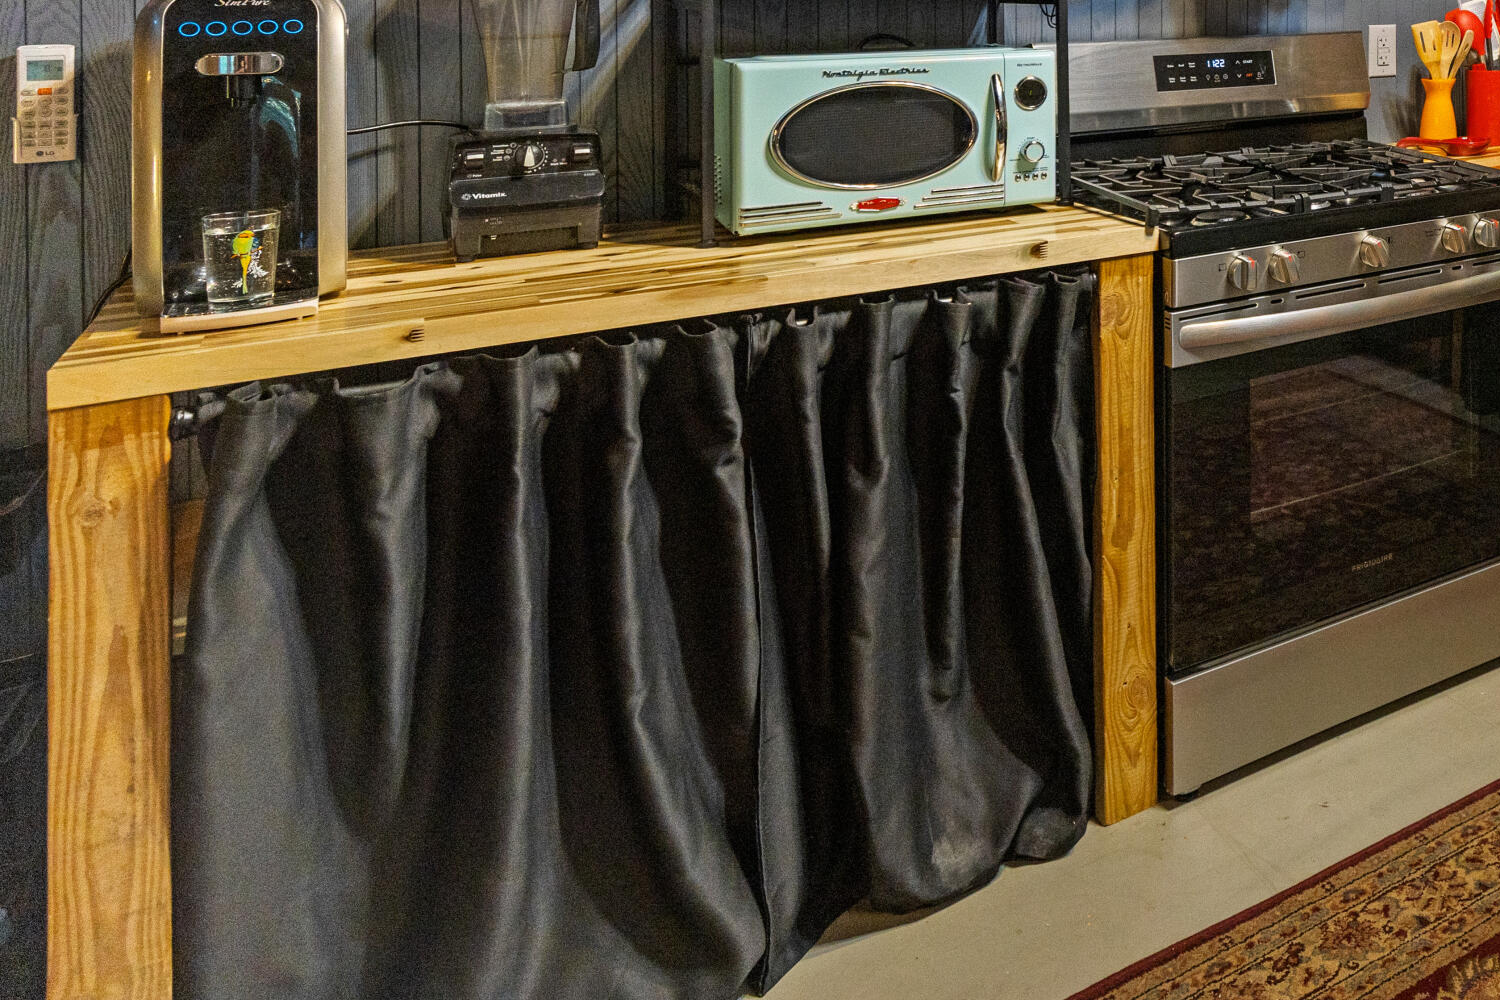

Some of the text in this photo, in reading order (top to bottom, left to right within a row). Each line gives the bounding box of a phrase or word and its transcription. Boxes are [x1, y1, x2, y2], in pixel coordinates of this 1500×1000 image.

[822, 67, 929, 81] Nostalgia Electrics
[472, 192, 507, 200] Vitamix
